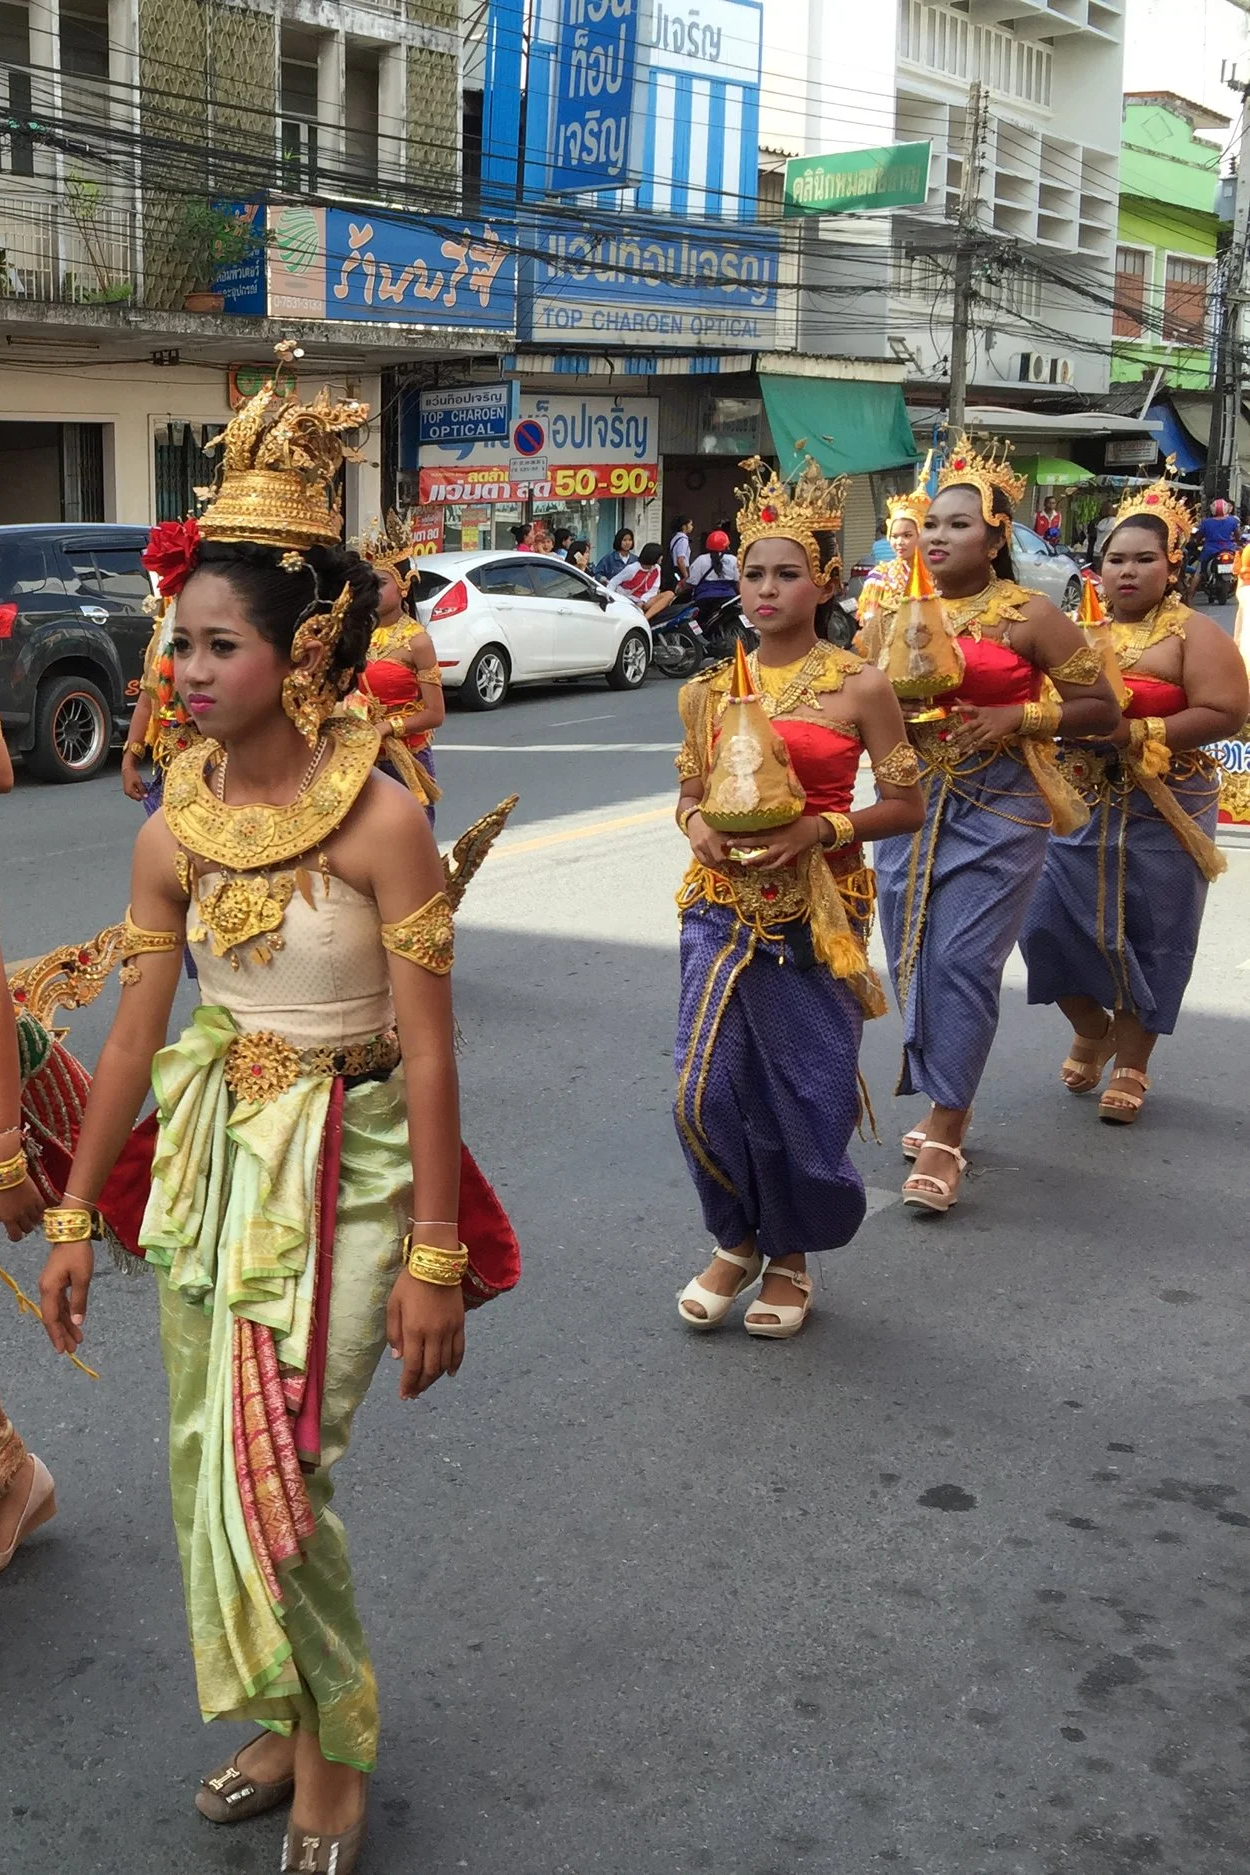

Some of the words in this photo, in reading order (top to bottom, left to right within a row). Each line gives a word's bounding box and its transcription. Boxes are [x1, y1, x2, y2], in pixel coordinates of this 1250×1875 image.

[569, 23, 627, 98] ท็อป
[558, 110, 627, 175] เจริญ
[543, 307, 583, 329] TOP
[592, 310, 683, 336] CHAROEN
[690, 316, 761, 339] OPTICAL
[422, 411, 444, 425] TOP
[451, 406, 505, 422] CHAROEN
[430, 423, 495, 438] OPTICAL
